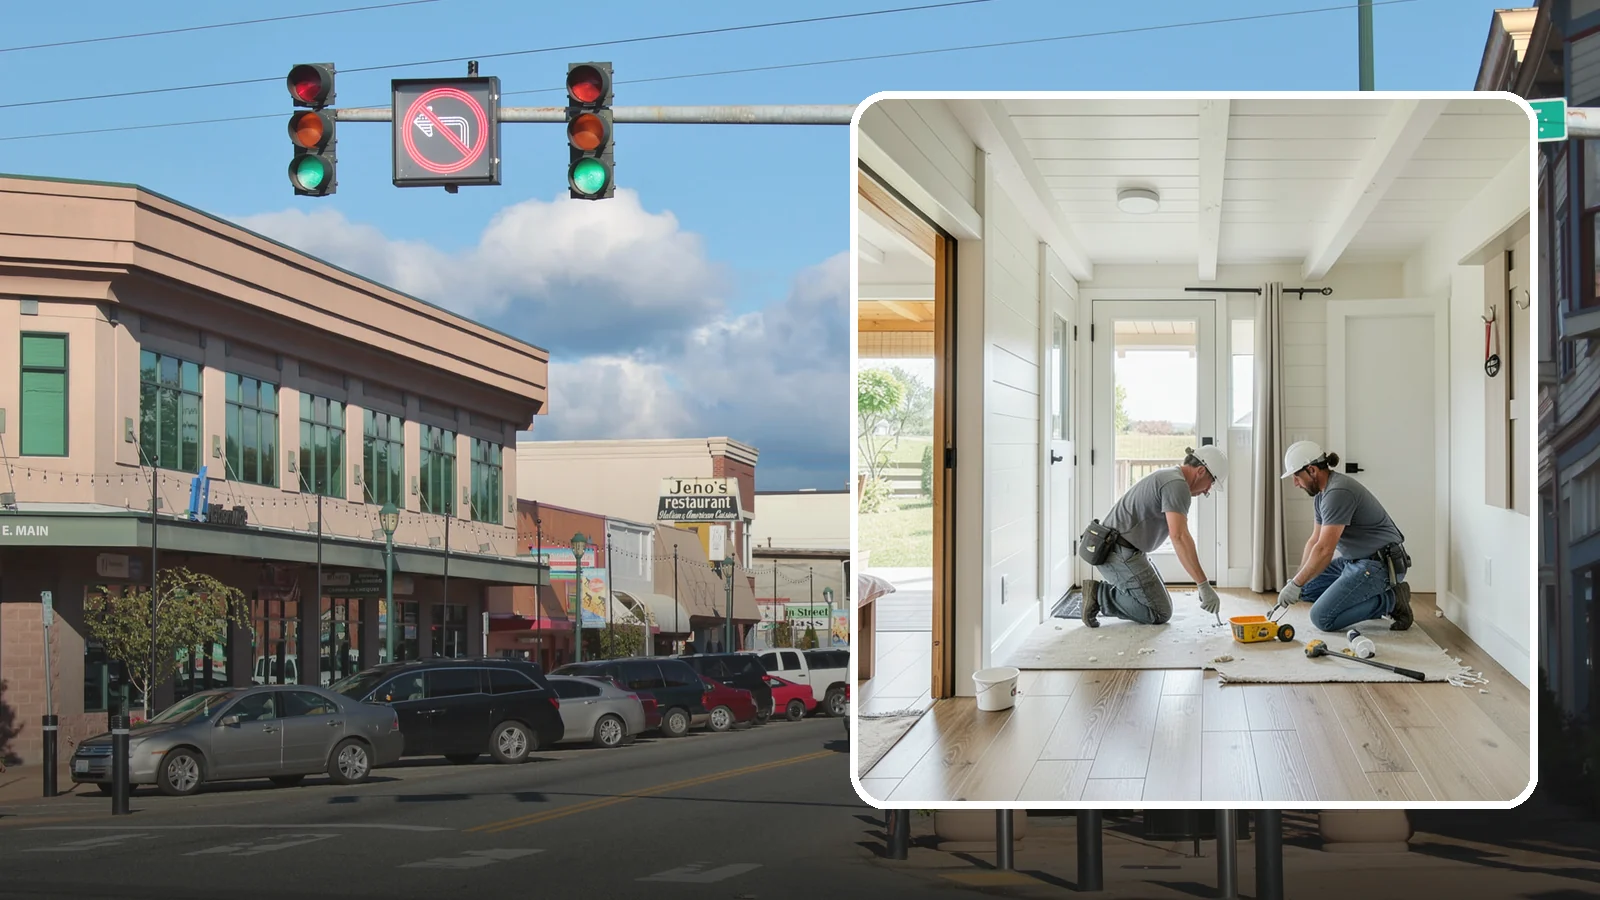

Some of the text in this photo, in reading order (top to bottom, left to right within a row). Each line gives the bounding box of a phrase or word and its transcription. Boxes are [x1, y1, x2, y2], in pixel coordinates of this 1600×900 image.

[669, 480, 728, 495] Jeno's
[665, 496, 731, 509] restaurant
[658, 509, 681, 519] Italian
[686, 509, 714, 519] American
[715, 509, 737, 519] Cuisine
[2, 525, 49, 536] E. MAIN
[797, 607, 828, 617] Street
